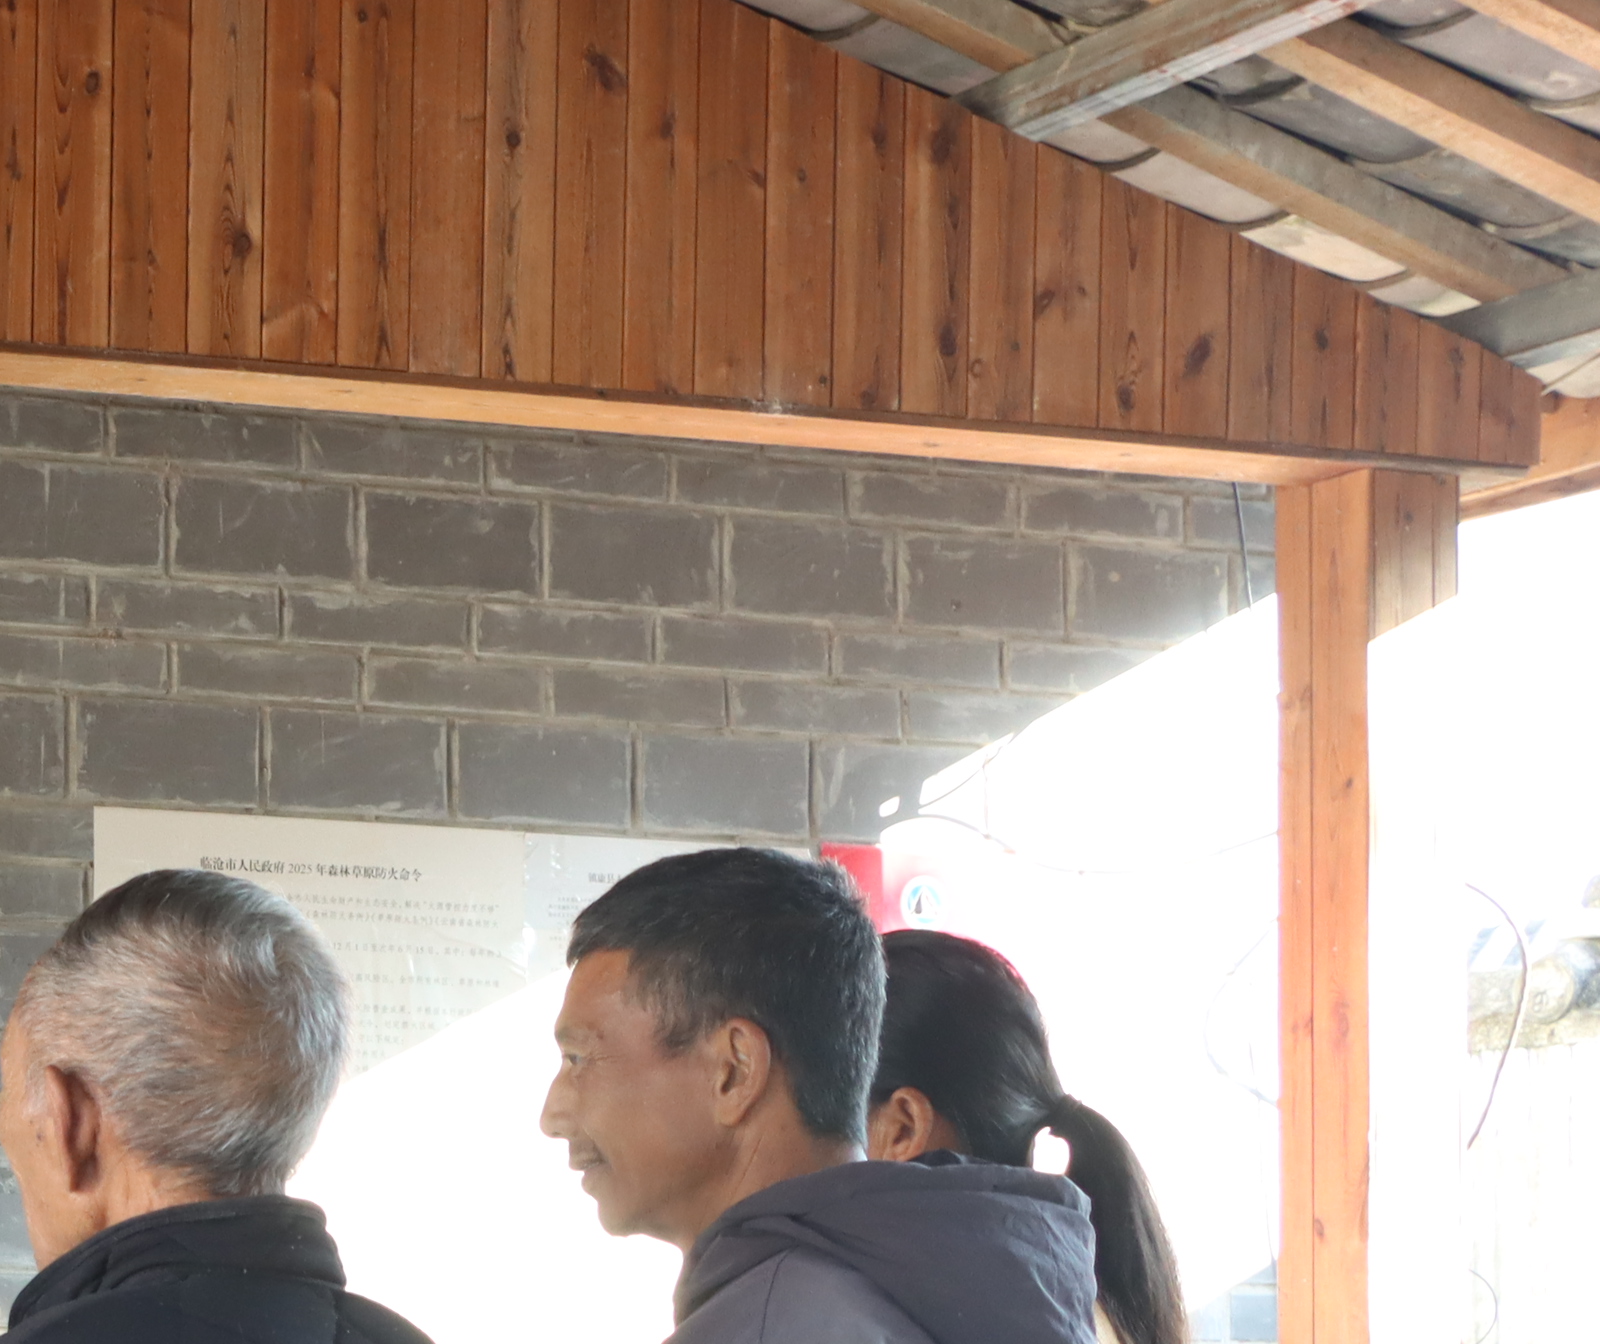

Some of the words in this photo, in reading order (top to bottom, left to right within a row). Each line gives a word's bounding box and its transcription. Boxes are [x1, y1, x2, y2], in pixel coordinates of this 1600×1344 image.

[200, 857, 284, 874] 临沧市人民政府
[288, 863, 312, 874] 2025
[316, 863, 422, 882] 年森林草原防火命令
